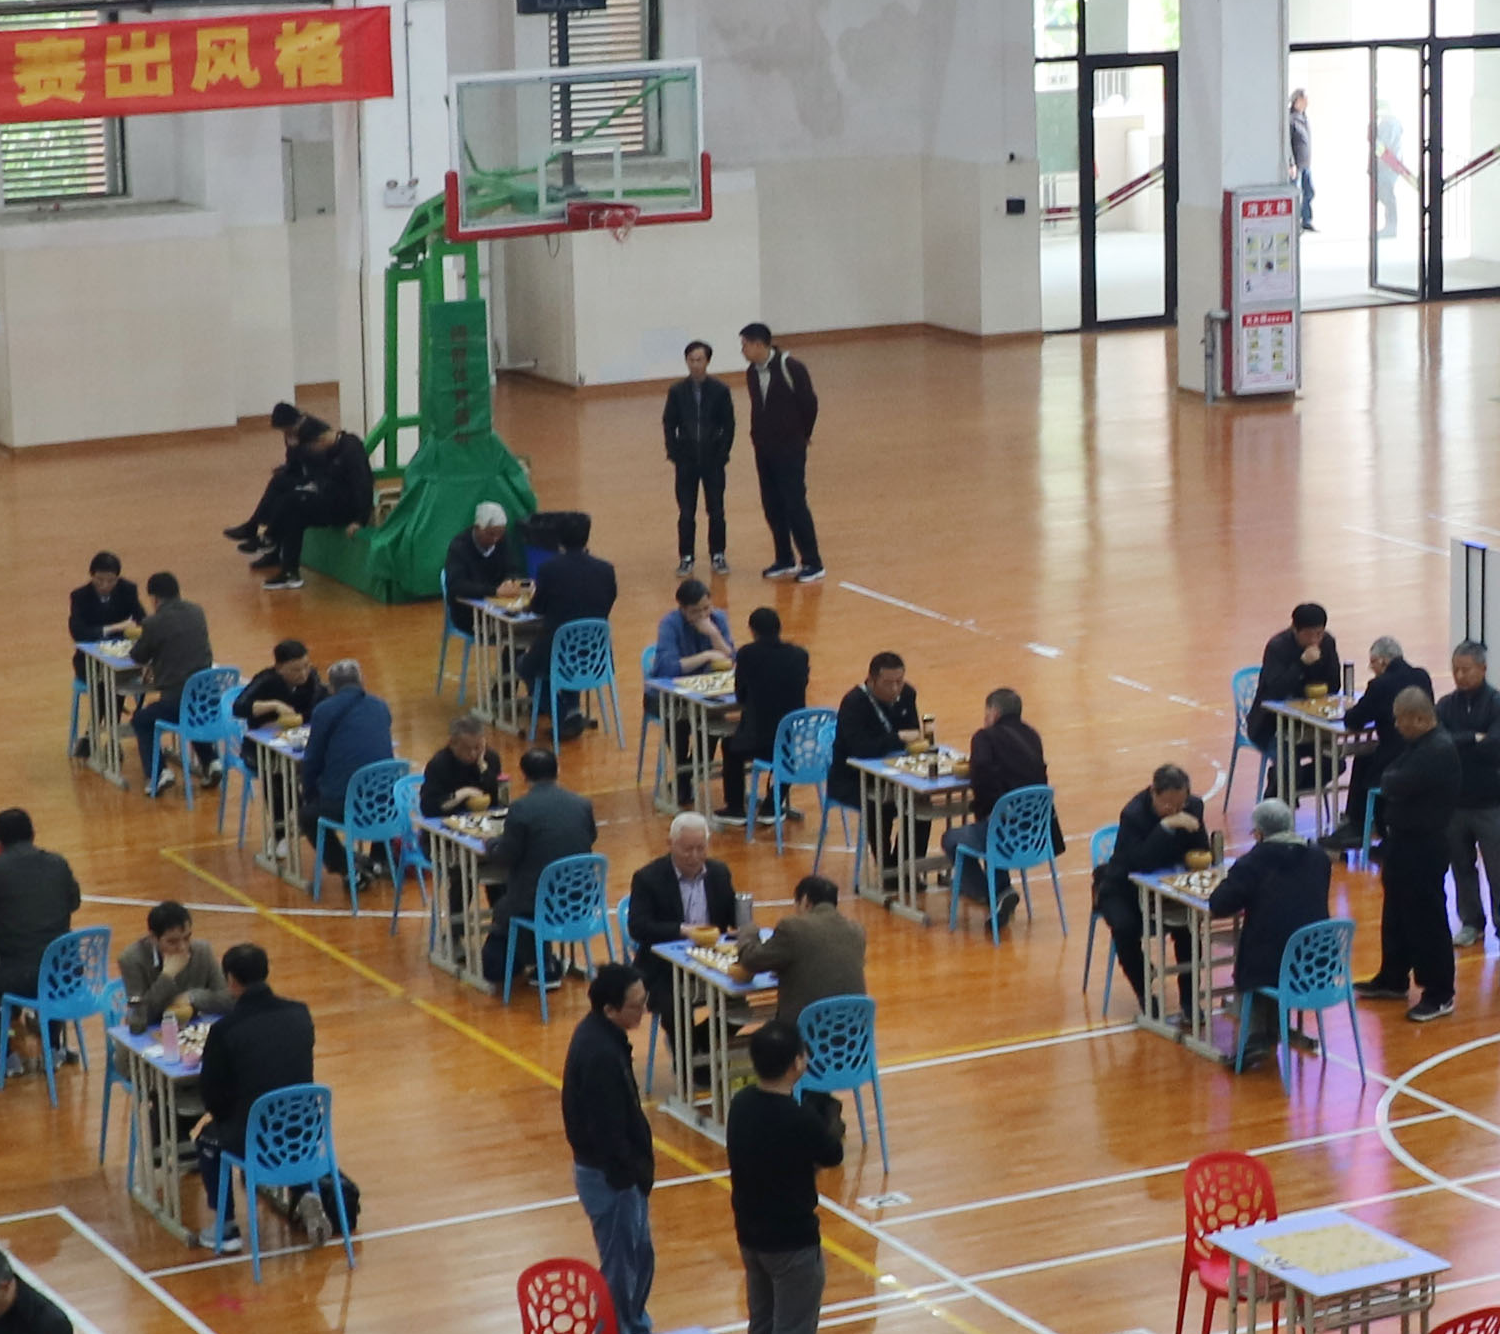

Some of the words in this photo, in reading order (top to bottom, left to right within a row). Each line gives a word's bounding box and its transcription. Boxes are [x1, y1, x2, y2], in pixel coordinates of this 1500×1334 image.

[15, 22, 344, 106] 赛出风格
[1246, 201, 1288, 217] 消火栓
